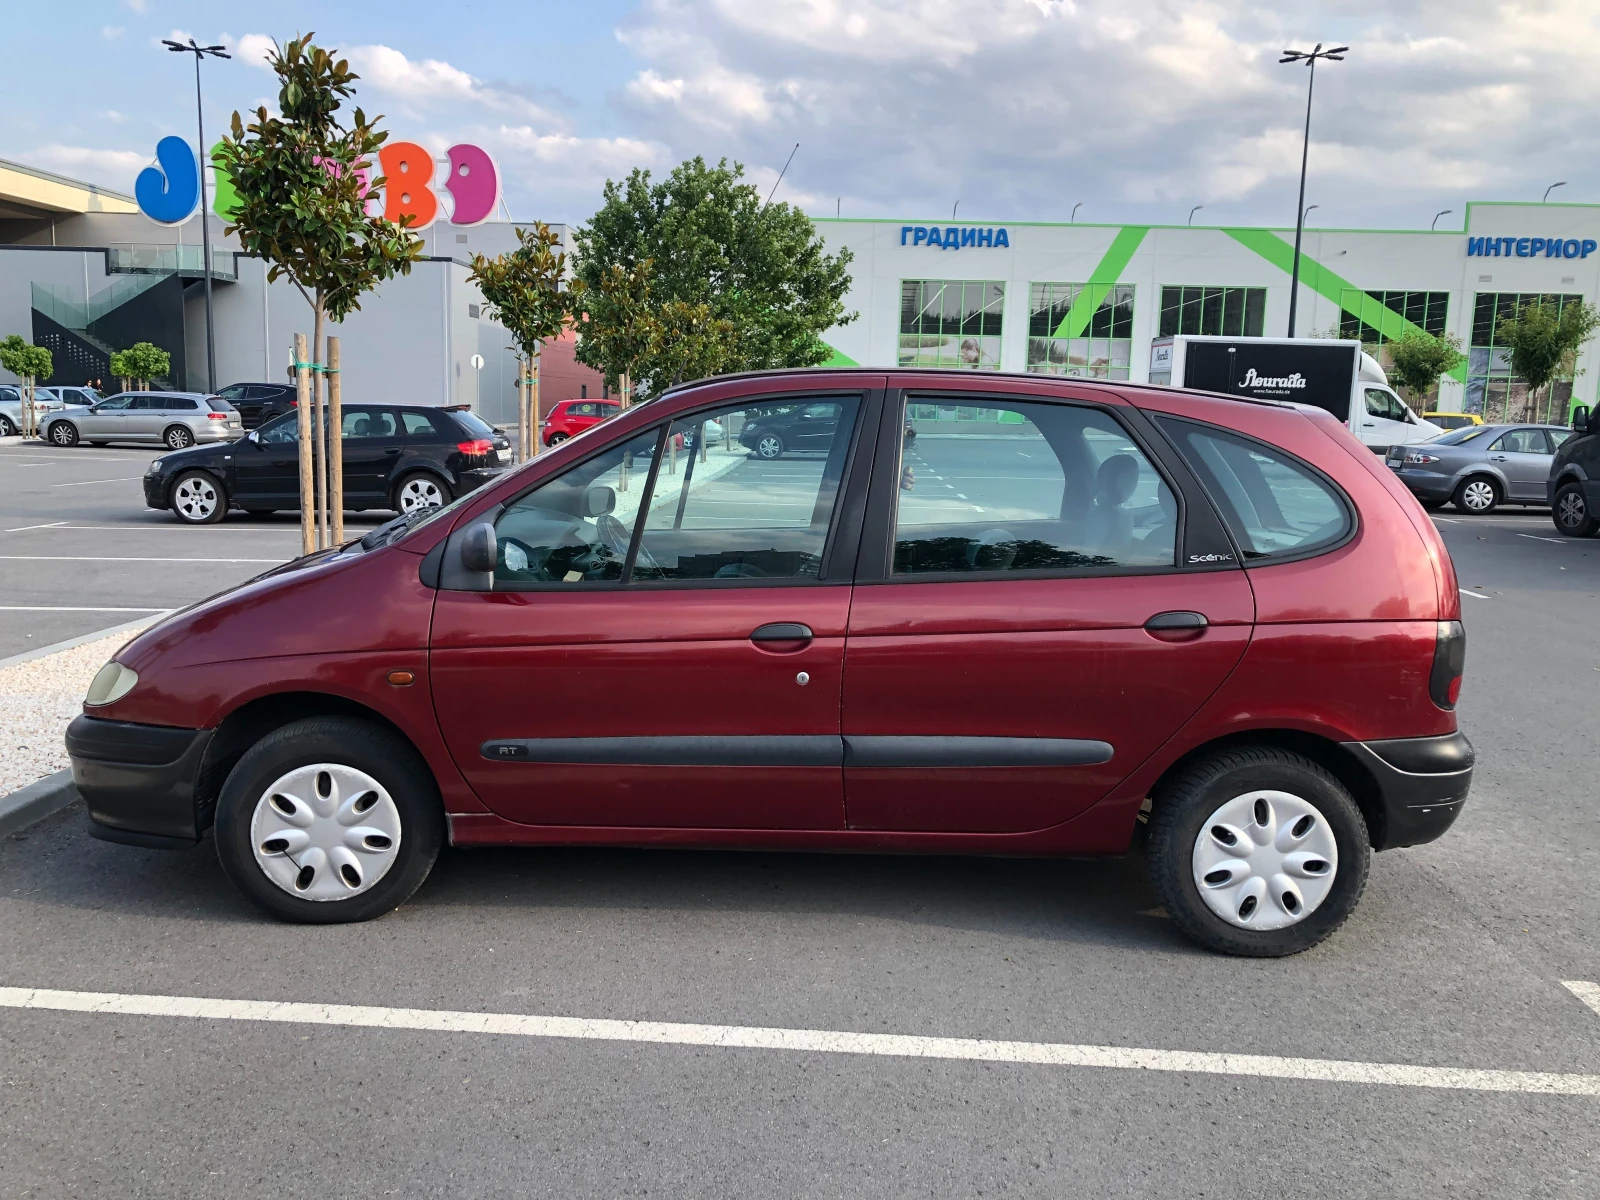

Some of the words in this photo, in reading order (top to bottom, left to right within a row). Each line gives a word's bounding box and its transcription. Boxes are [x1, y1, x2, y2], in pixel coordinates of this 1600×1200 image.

[134, 135, 499, 230] JBO
[901, 226, 1010, 250] ГРАДИНА
[1467, 236, 1597, 259] ИНТЕРИОР
[499, 746, 517, 755] RT
